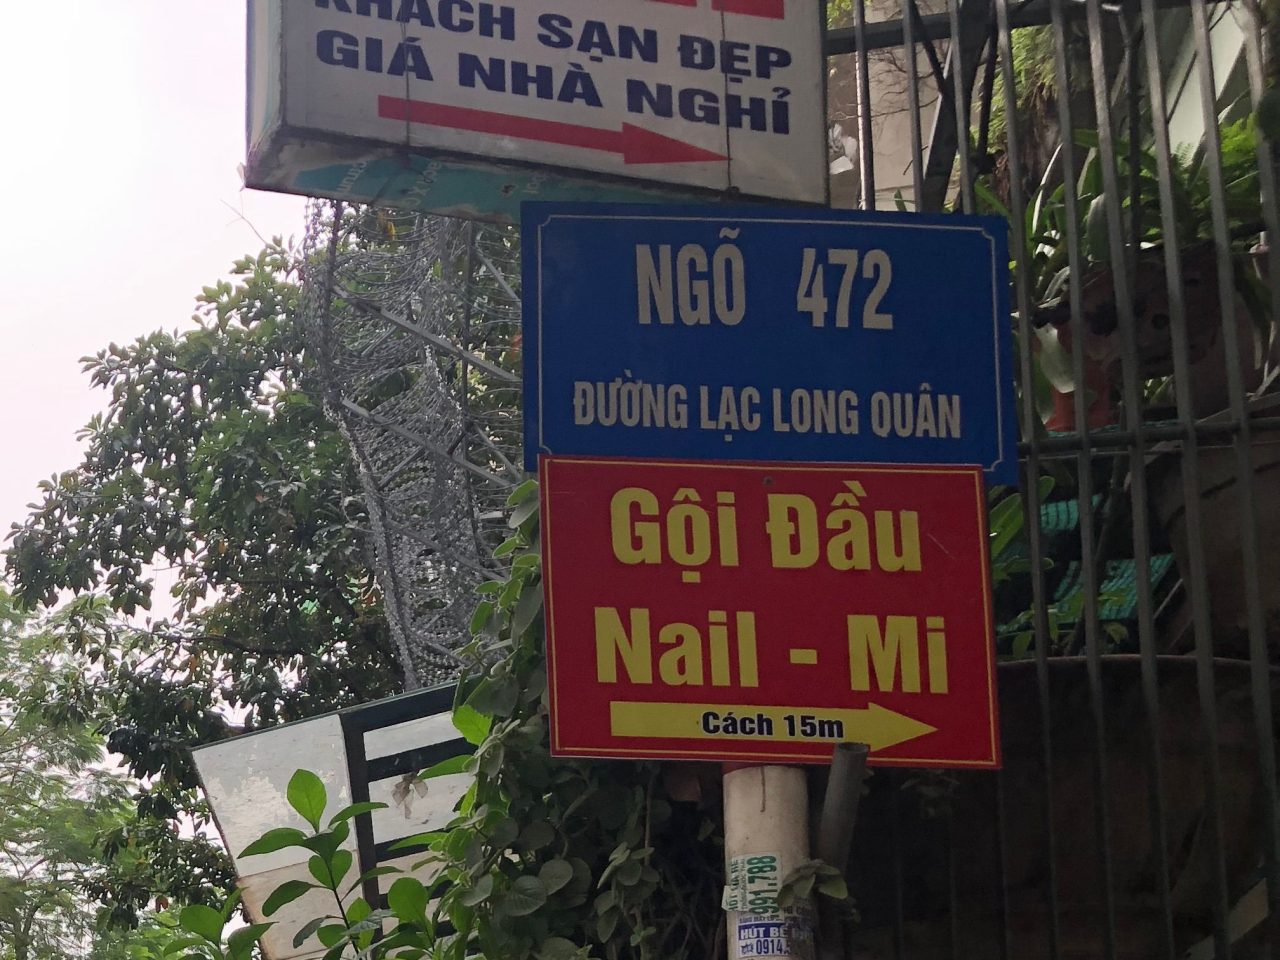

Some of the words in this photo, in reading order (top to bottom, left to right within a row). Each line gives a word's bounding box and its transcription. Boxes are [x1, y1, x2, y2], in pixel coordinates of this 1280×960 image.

[316, 29, 434, 82] GIÁ
[458, 51, 604, 108] NHÀ
[625, 78, 792, 135] NGHỈ
[537, 12, 659, 64] SẠN
[677, 33, 793, 83] ĐẸP
[636, 227, 746, 326] NGÕ
[797, 247, 893, 330] 472
[573, 369, 688, 429] ĐƯỜNG
[700, 384, 761, 442] LẠC
[773, 387, 859, 435] LONG
[870, 382, 961, 439] QUÂN
[610, 485, 740, 583] Gội
[766, 480, 923, 572] Đầu
[594, 606, 759, 688] Nail
[847, 613, 949, 695] Mi
[701, 711, 773, 737] Cách
[783, 714, 845, 739] 15m
[740, 926, 766, 939] HÚT
